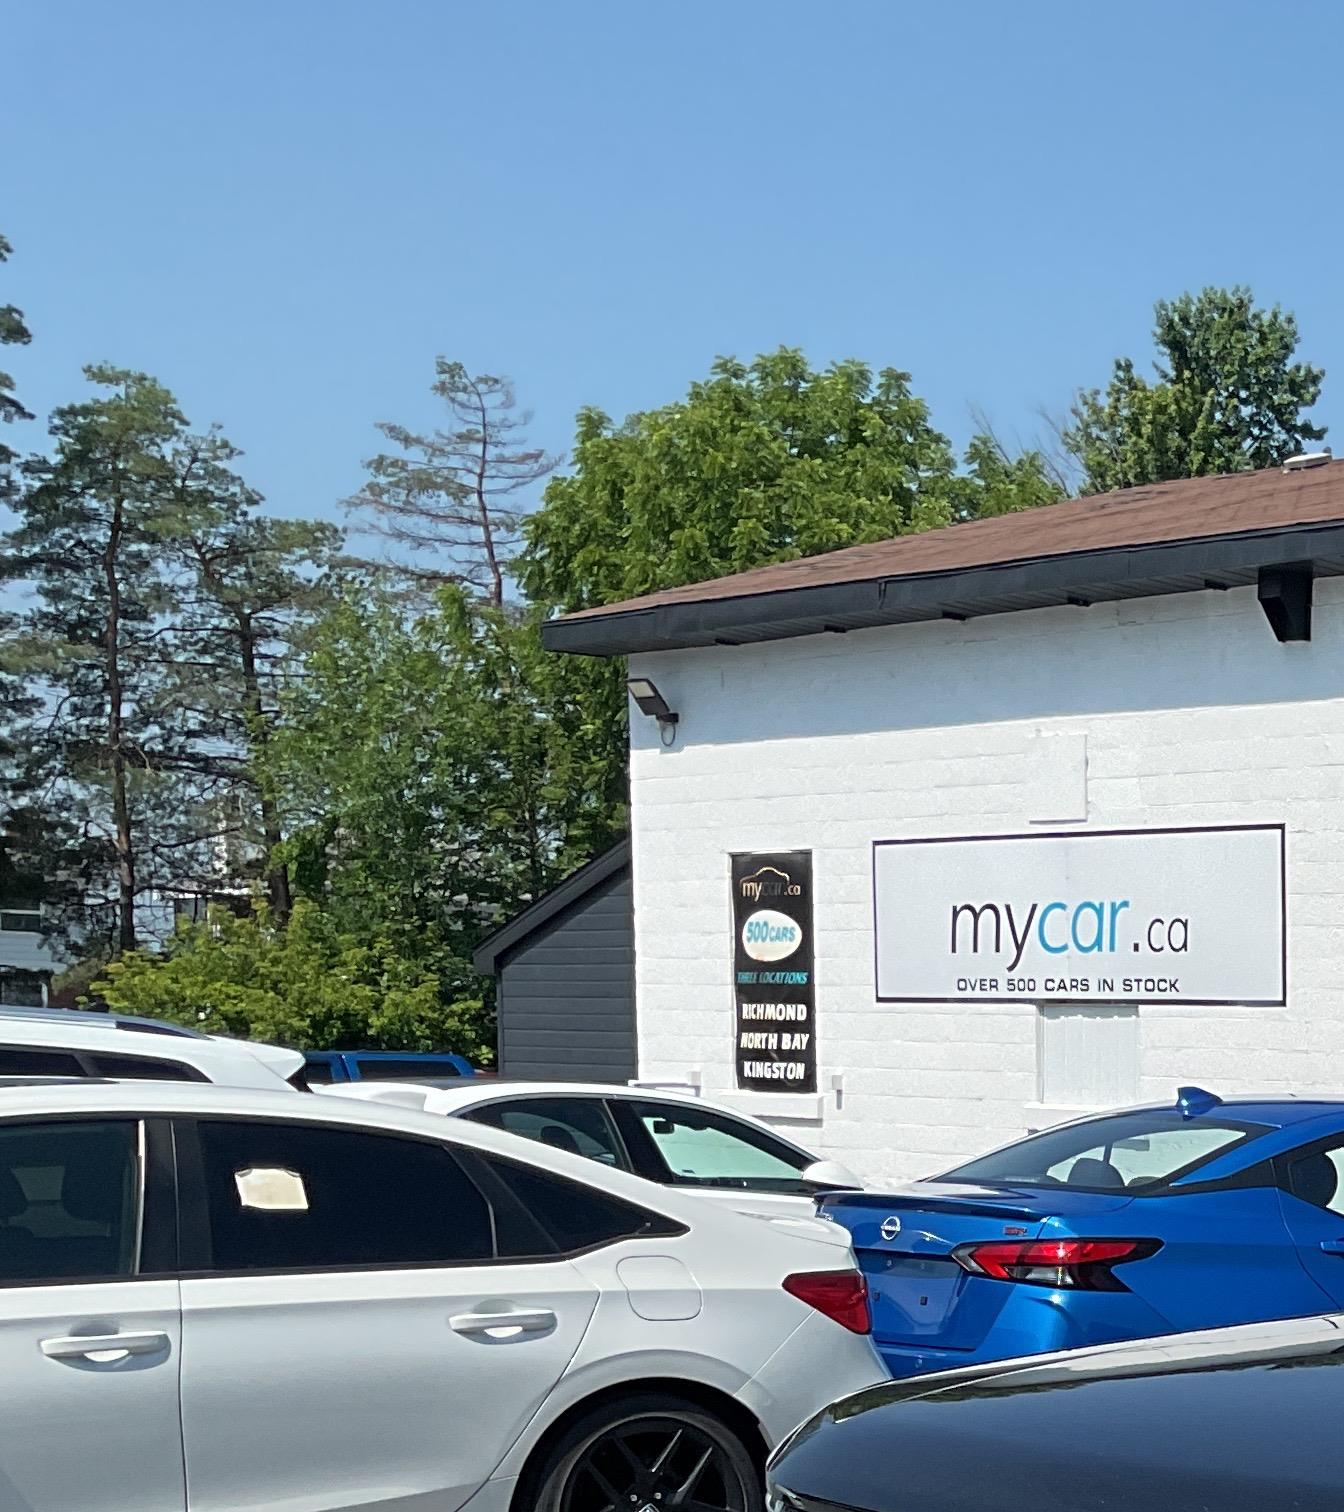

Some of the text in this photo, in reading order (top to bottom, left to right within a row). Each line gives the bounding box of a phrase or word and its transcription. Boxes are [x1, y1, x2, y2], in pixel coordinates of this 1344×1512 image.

[950, 899, 1190, 972] mycar.ca
[760, 971, 809, 985] LOCATIONS
[956, 978, 1181, 993] OVER 500 CARS IN STOCK
[742, 1003, 807, 1021] RICHMOND
[740, 1032, 810, 1051] NORTH BAY
[743, 1061, 806, 1080] KINGSTON
